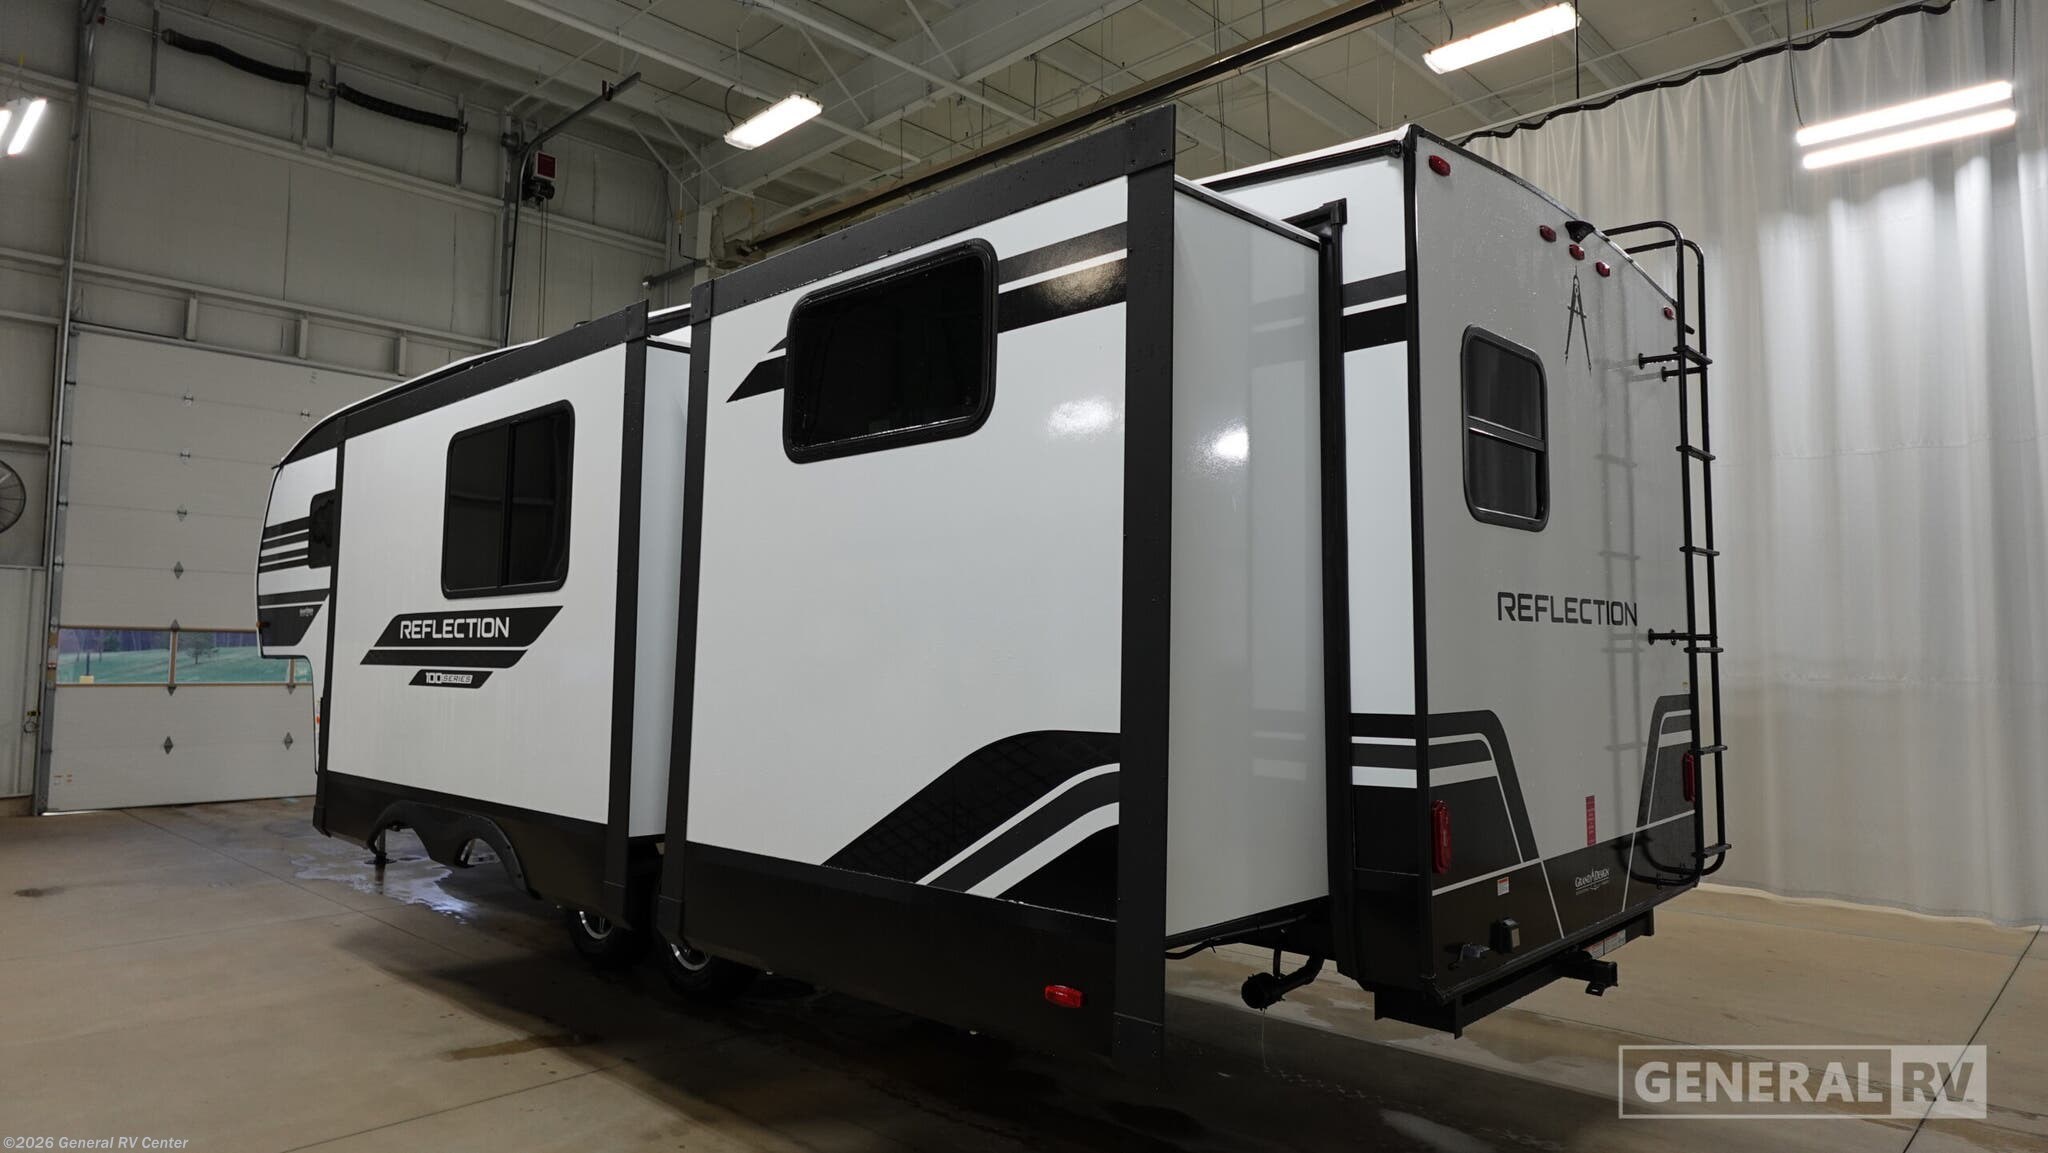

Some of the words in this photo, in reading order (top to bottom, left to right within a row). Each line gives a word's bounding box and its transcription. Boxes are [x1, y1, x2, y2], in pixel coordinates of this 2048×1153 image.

[1497, 592, 1637, 626] REFLECTION
[400, 617, 509, 639] REFLECTION
[426, 672, 442, 684] 100
